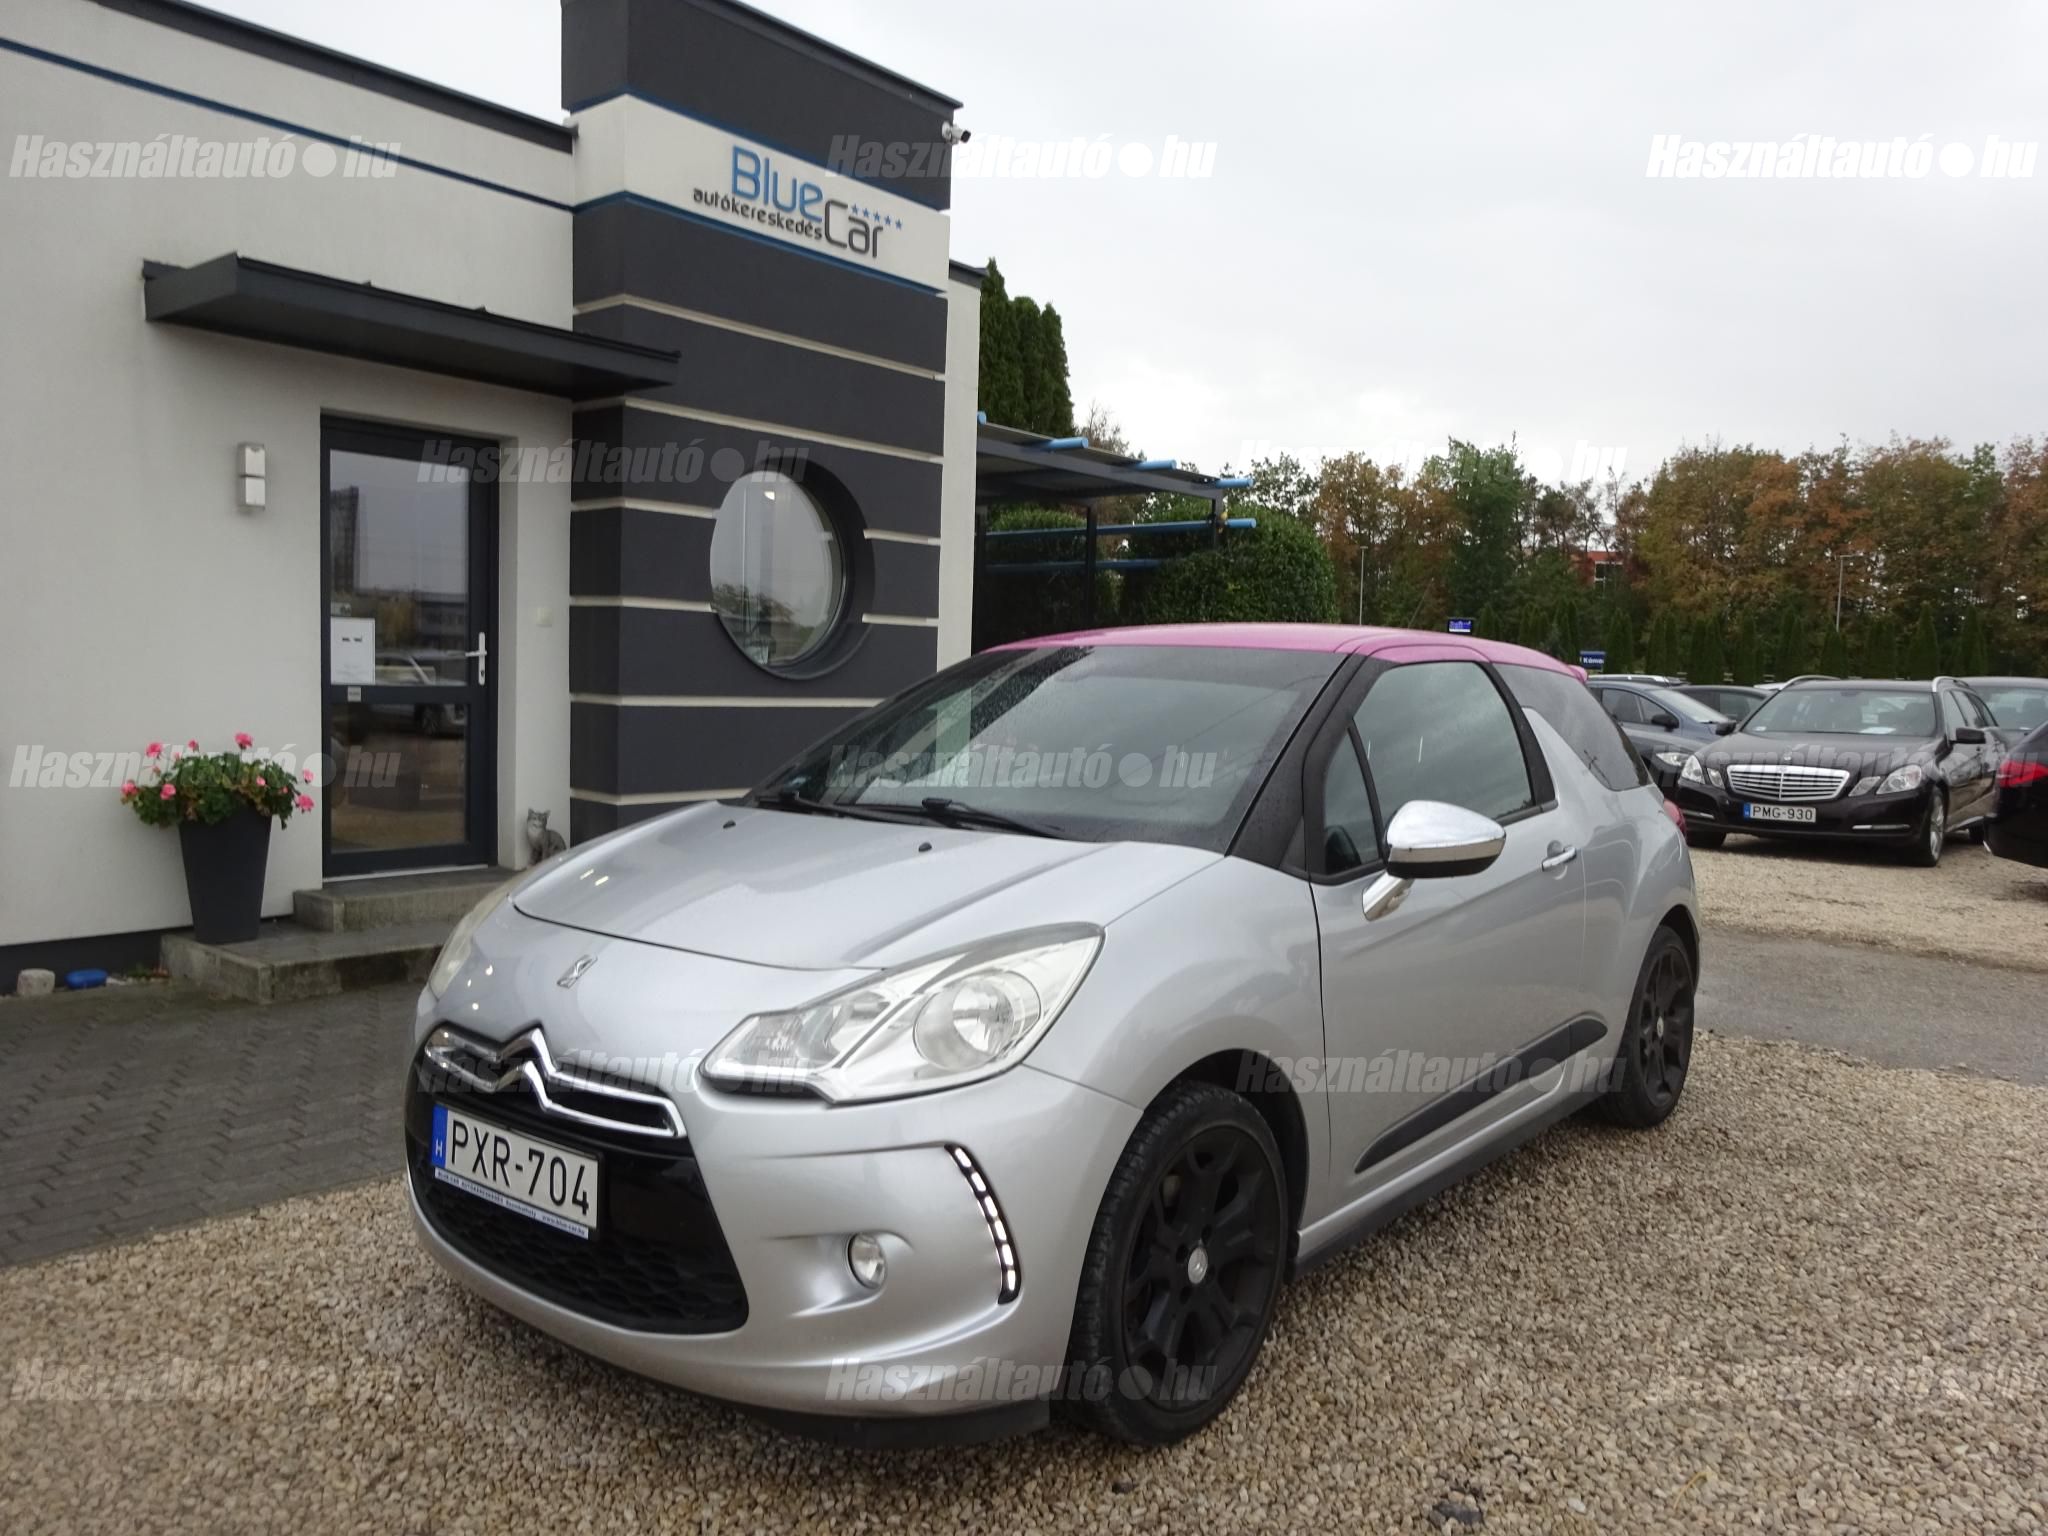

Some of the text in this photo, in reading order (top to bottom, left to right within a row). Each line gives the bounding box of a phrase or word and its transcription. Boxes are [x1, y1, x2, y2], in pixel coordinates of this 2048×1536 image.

[693, 188, 823, 241] autókereskedés
[1752, 805, 1814, 821] PMG-930
[451, 1119, 590, 1216] PXR-704
